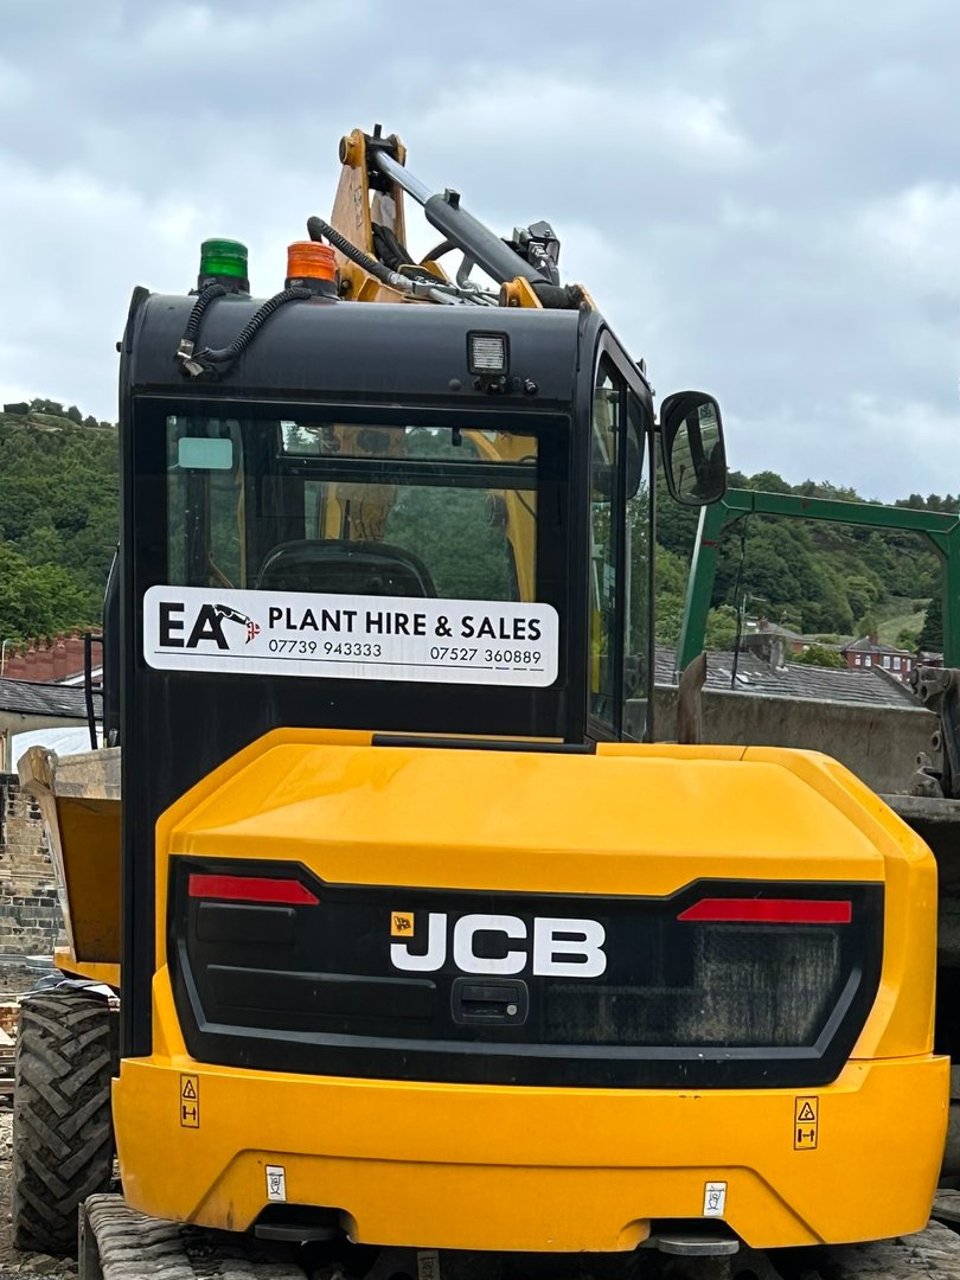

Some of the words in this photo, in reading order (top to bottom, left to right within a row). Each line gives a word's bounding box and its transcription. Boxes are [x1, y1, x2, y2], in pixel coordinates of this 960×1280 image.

[159, 601, 230, 650] EA
[268, 606, 358, 633] PLANT
[365, 611, 426, 636] HIRE
[434, 615, 453, 638] &
[460, 615, 541, 641] SALES
[268, 639, 317, 655] 07739
[324, 641, 382, 657] 943333
[430, 646, 478, 661] 07527
[484, 649, 541, 664] 360889
[390, 912, 608, 978] JCB
